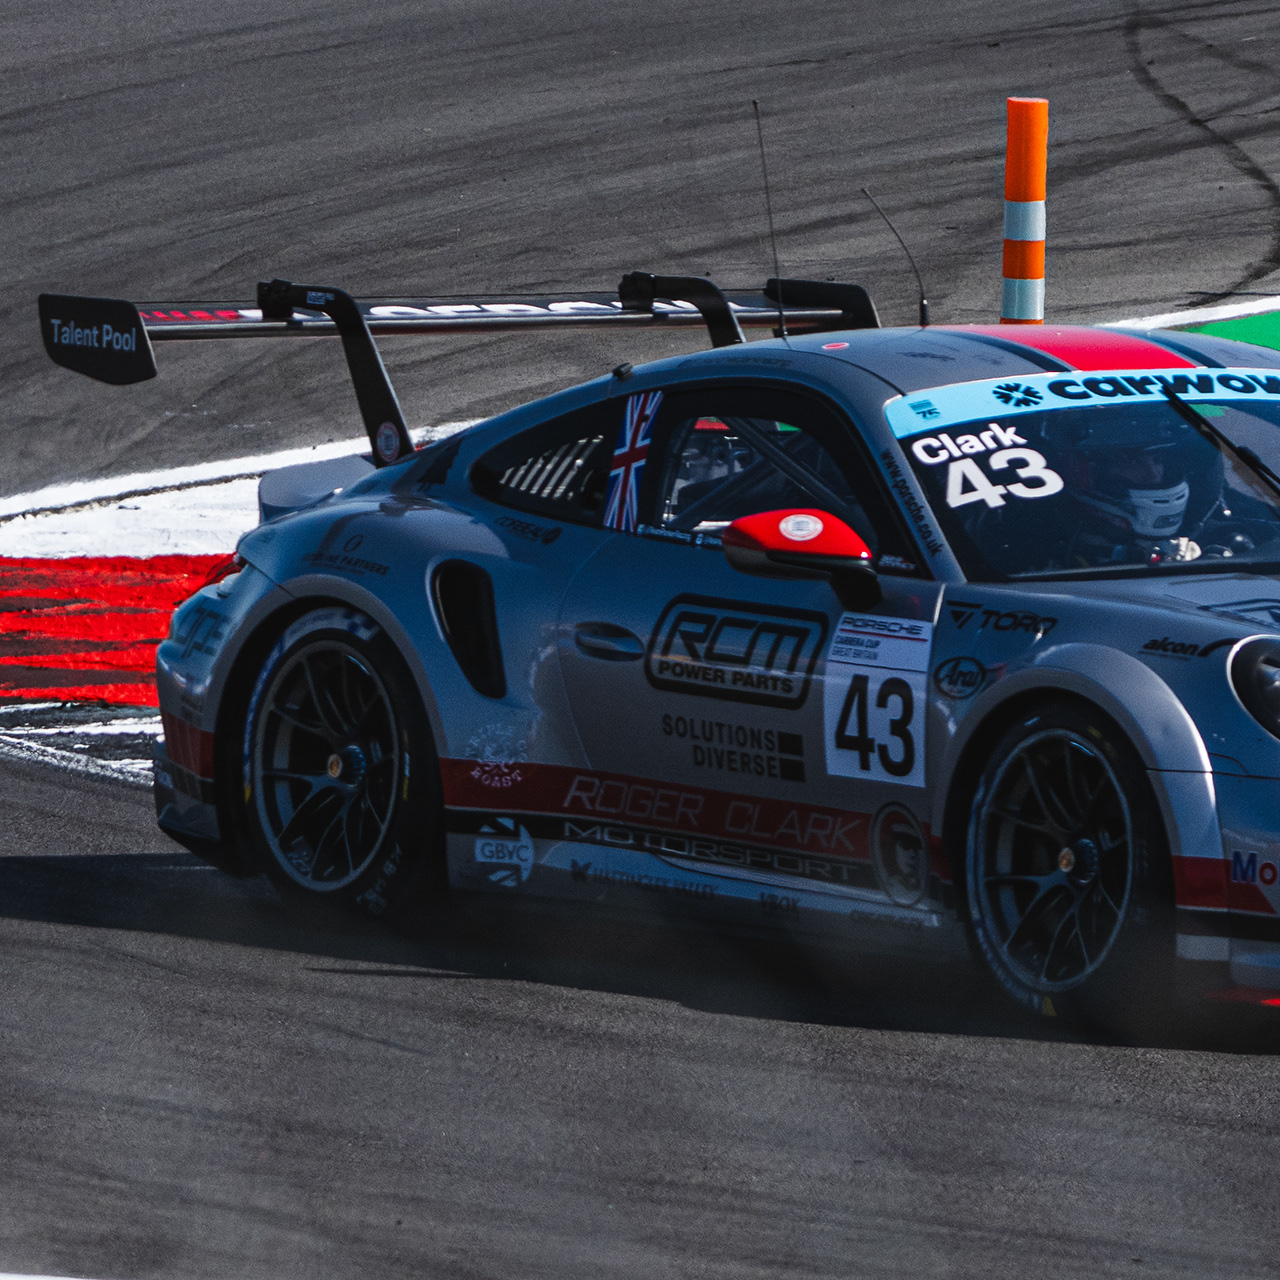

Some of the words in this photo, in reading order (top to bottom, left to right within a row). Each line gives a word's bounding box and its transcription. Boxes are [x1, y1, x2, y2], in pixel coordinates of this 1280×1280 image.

[51, 320, 99, 348] Talent
[102, 324, 137, 352] Pool
[911, 423, 1028, 466] Clark
[880, 449, 945, 557] www.porsche.co.uk
[946, 447, 1065, 509] 43
[658, 610, 814, 673] RCM
[1142, 637, 1199, 656] alcon
[657, 658, 727, 686] POWER
[732, 672, 794, 694] PARTS
[661, 714, 777, 753] SOLUTIONS
[834, 673, 915, 777] 43
[693, 744, 779, 779] DIVERSE
[562, 775, 705, 825] ROGER
[725, 801, 862, 851] CLARK
[562, 822, 860, 881] MOTORSPORT
